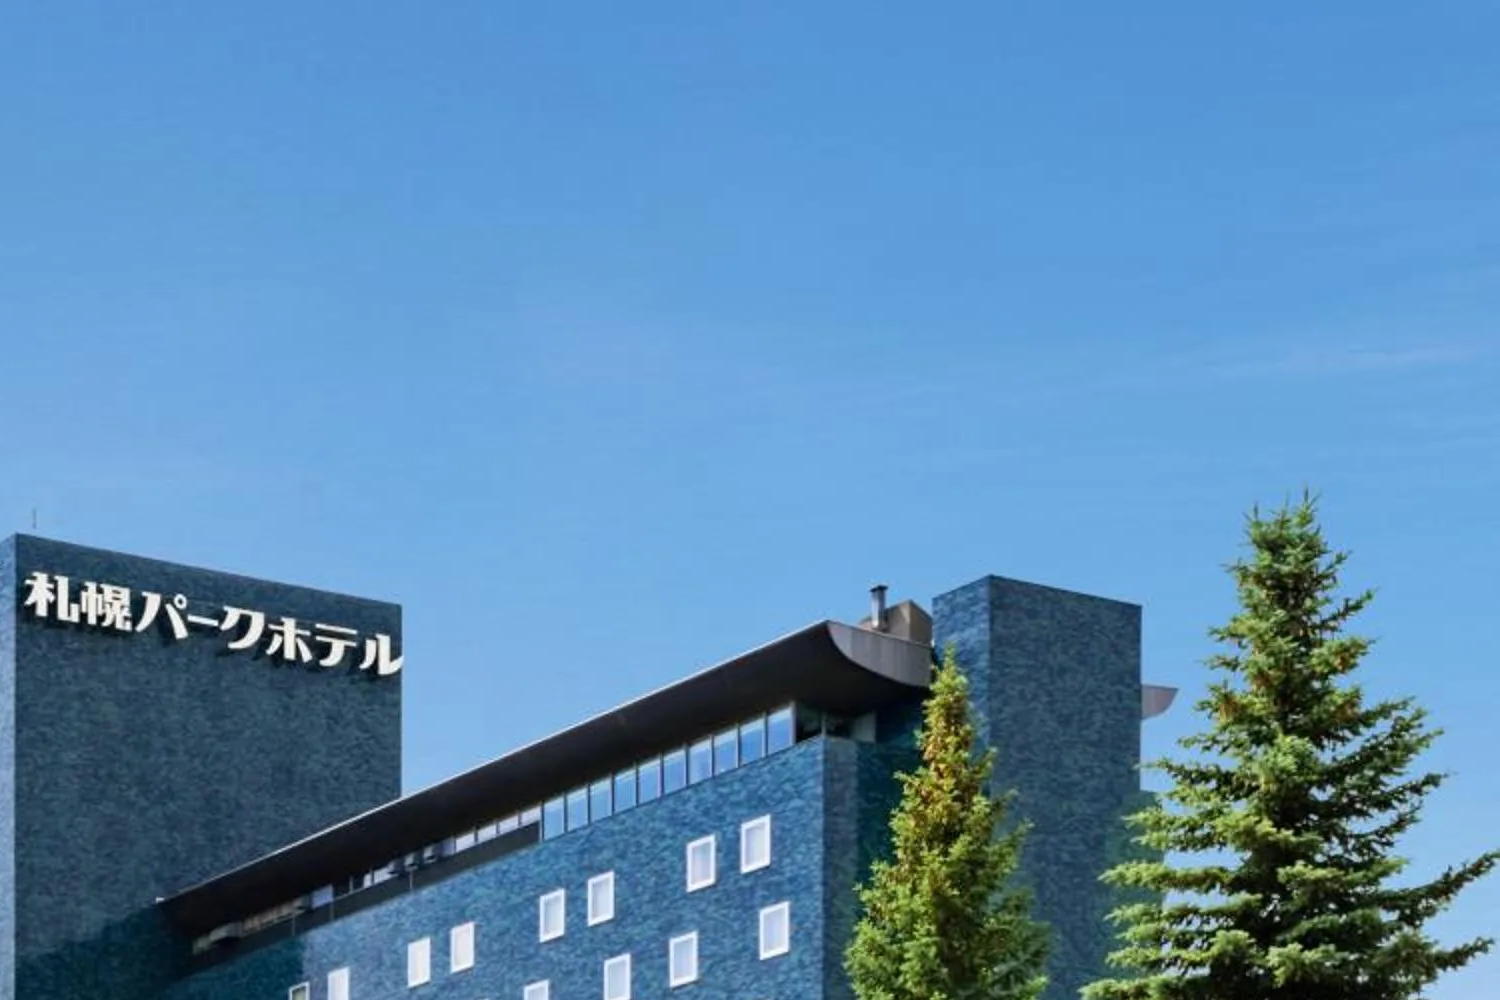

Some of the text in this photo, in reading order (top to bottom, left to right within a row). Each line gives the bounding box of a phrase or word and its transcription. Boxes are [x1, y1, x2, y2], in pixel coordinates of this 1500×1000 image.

[23, 571, 404, 676] 札幌パークホテル
